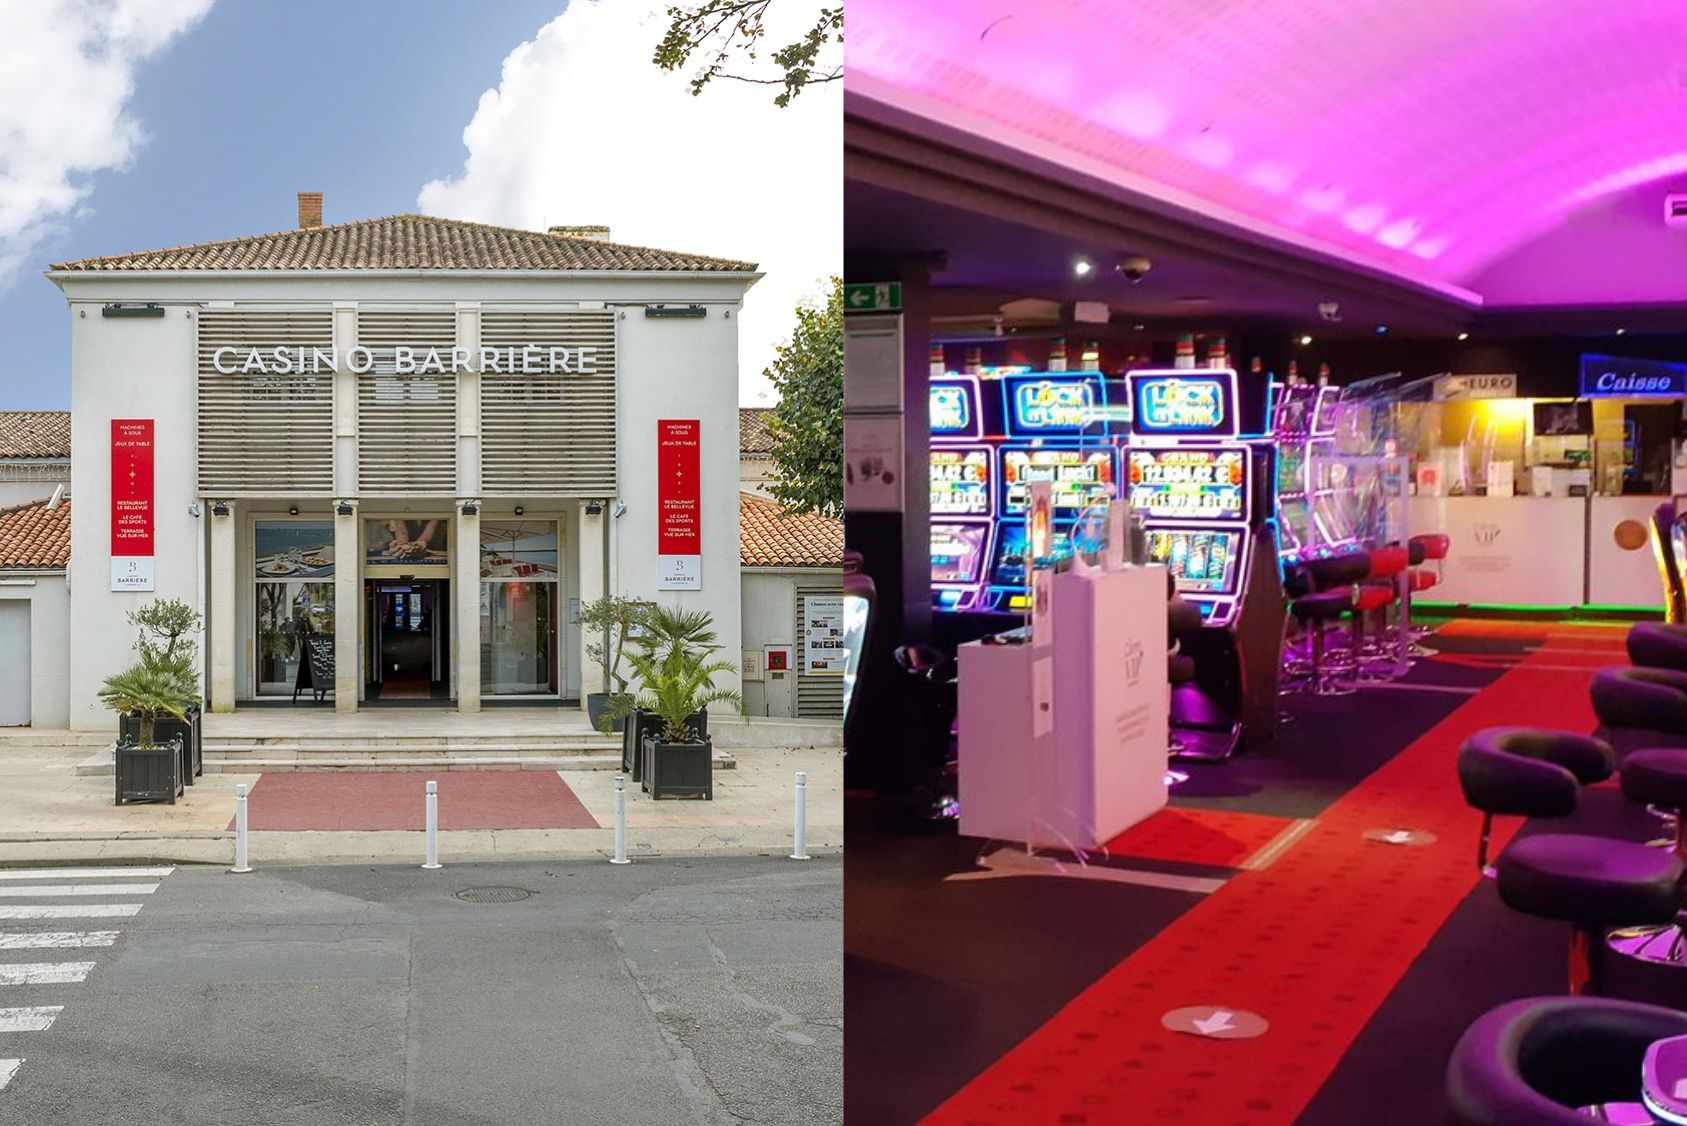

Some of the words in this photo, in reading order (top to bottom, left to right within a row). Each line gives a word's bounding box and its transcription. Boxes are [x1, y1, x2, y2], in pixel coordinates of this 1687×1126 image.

[213, 346, 373, 374] CASINO
[395, 343, 598, 374] BARRIÈRE
[1596, 372, 1671, 391] Caisse
